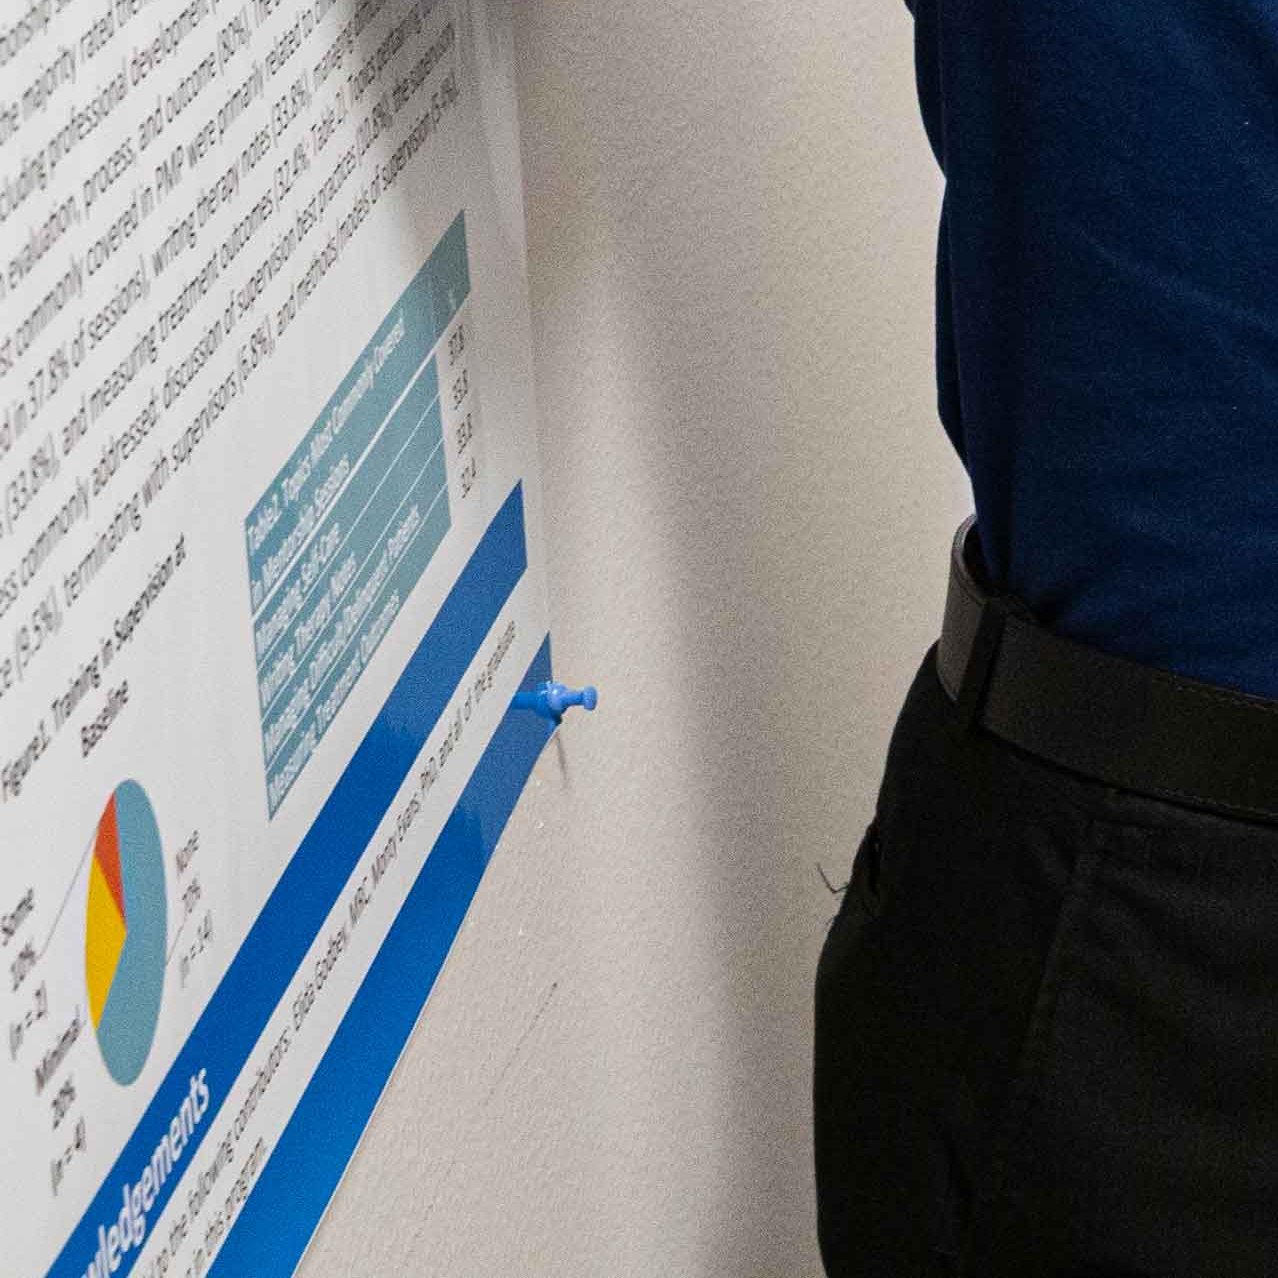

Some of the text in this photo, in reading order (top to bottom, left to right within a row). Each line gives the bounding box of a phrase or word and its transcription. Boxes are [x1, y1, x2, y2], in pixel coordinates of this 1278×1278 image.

[21, 45, 76, 114] majority
[79, 6, 113, 61] rated
[48, 70, 126, 172] professional
[8, 193, 82, 293] evaluation,
[83, 134, 139, 218] process,
[140, 101, 163, 154] and
[165, 49, 216, 126] outcome
[15, 6, 312, 360] commonly covered in PMP were primarily related to
[26, 346, 69, 423] 37.8%
[72, 316, 87, 371] of
[151, 208, 196, 279] writing
[196, 162, 240, 230] therapy
[241, 121, 271, 174] notes
[62, 393, 88, 459] and
[89, 322, 157, 423] measuring
[158, 249, 218, 345] treatment
[220, 186, 273, 272] outcomes
[20, 474, 89, 590] commonly
[163, 317, 221, 412] discussion
[223, 287, 235, 337] of
[236, 225, 296, 321] supervision
[296, 194, 317, 245] best
[317, 142, 356, 217] practices
[62, 489, 143, 610] terminating
[144, 451, 171, 510] with
[172, 368, 237, 475] supervisors
[275, 291, 295, 339] and
[283, 451, 311, 515] Topics
[50, 639, 101, 729] Training
[114, 566, 170, 656] Supervision
[329, 545, 356, 605] Notes
[79, 679, 130, 759] Baseline
[188, 1129, 235, 1219] following
